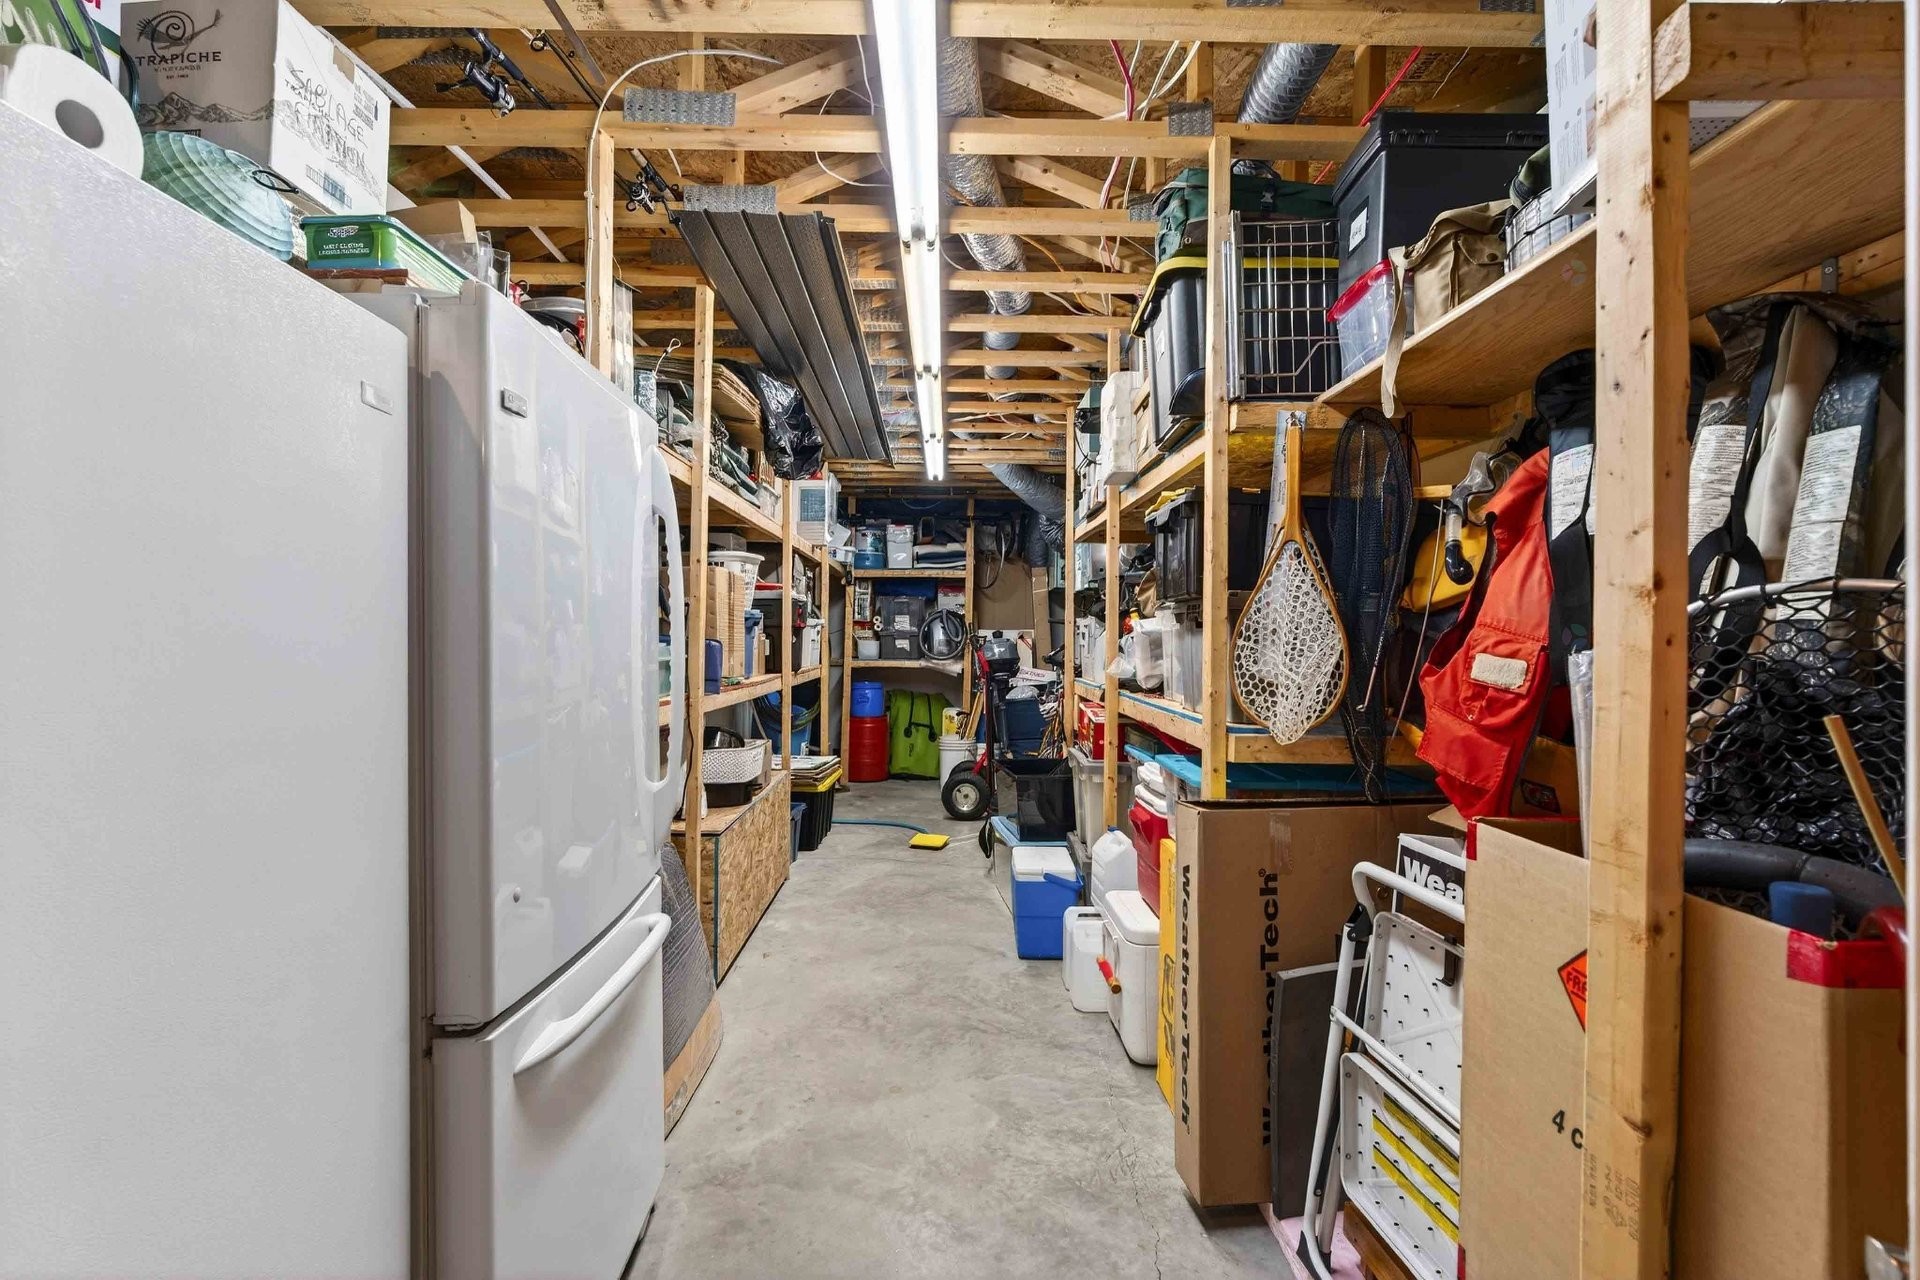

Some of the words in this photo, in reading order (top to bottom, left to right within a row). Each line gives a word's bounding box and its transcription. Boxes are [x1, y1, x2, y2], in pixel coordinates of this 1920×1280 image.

[135, 51, 222, 66] TRAPICHE
[290, 68, 369, 149] SABLAGE
[1403, 855, 1464, 906] Wea
[1181, 864, 1191, 1127] WeatherTech
[1551, 1109, 1566, 1134] 4
